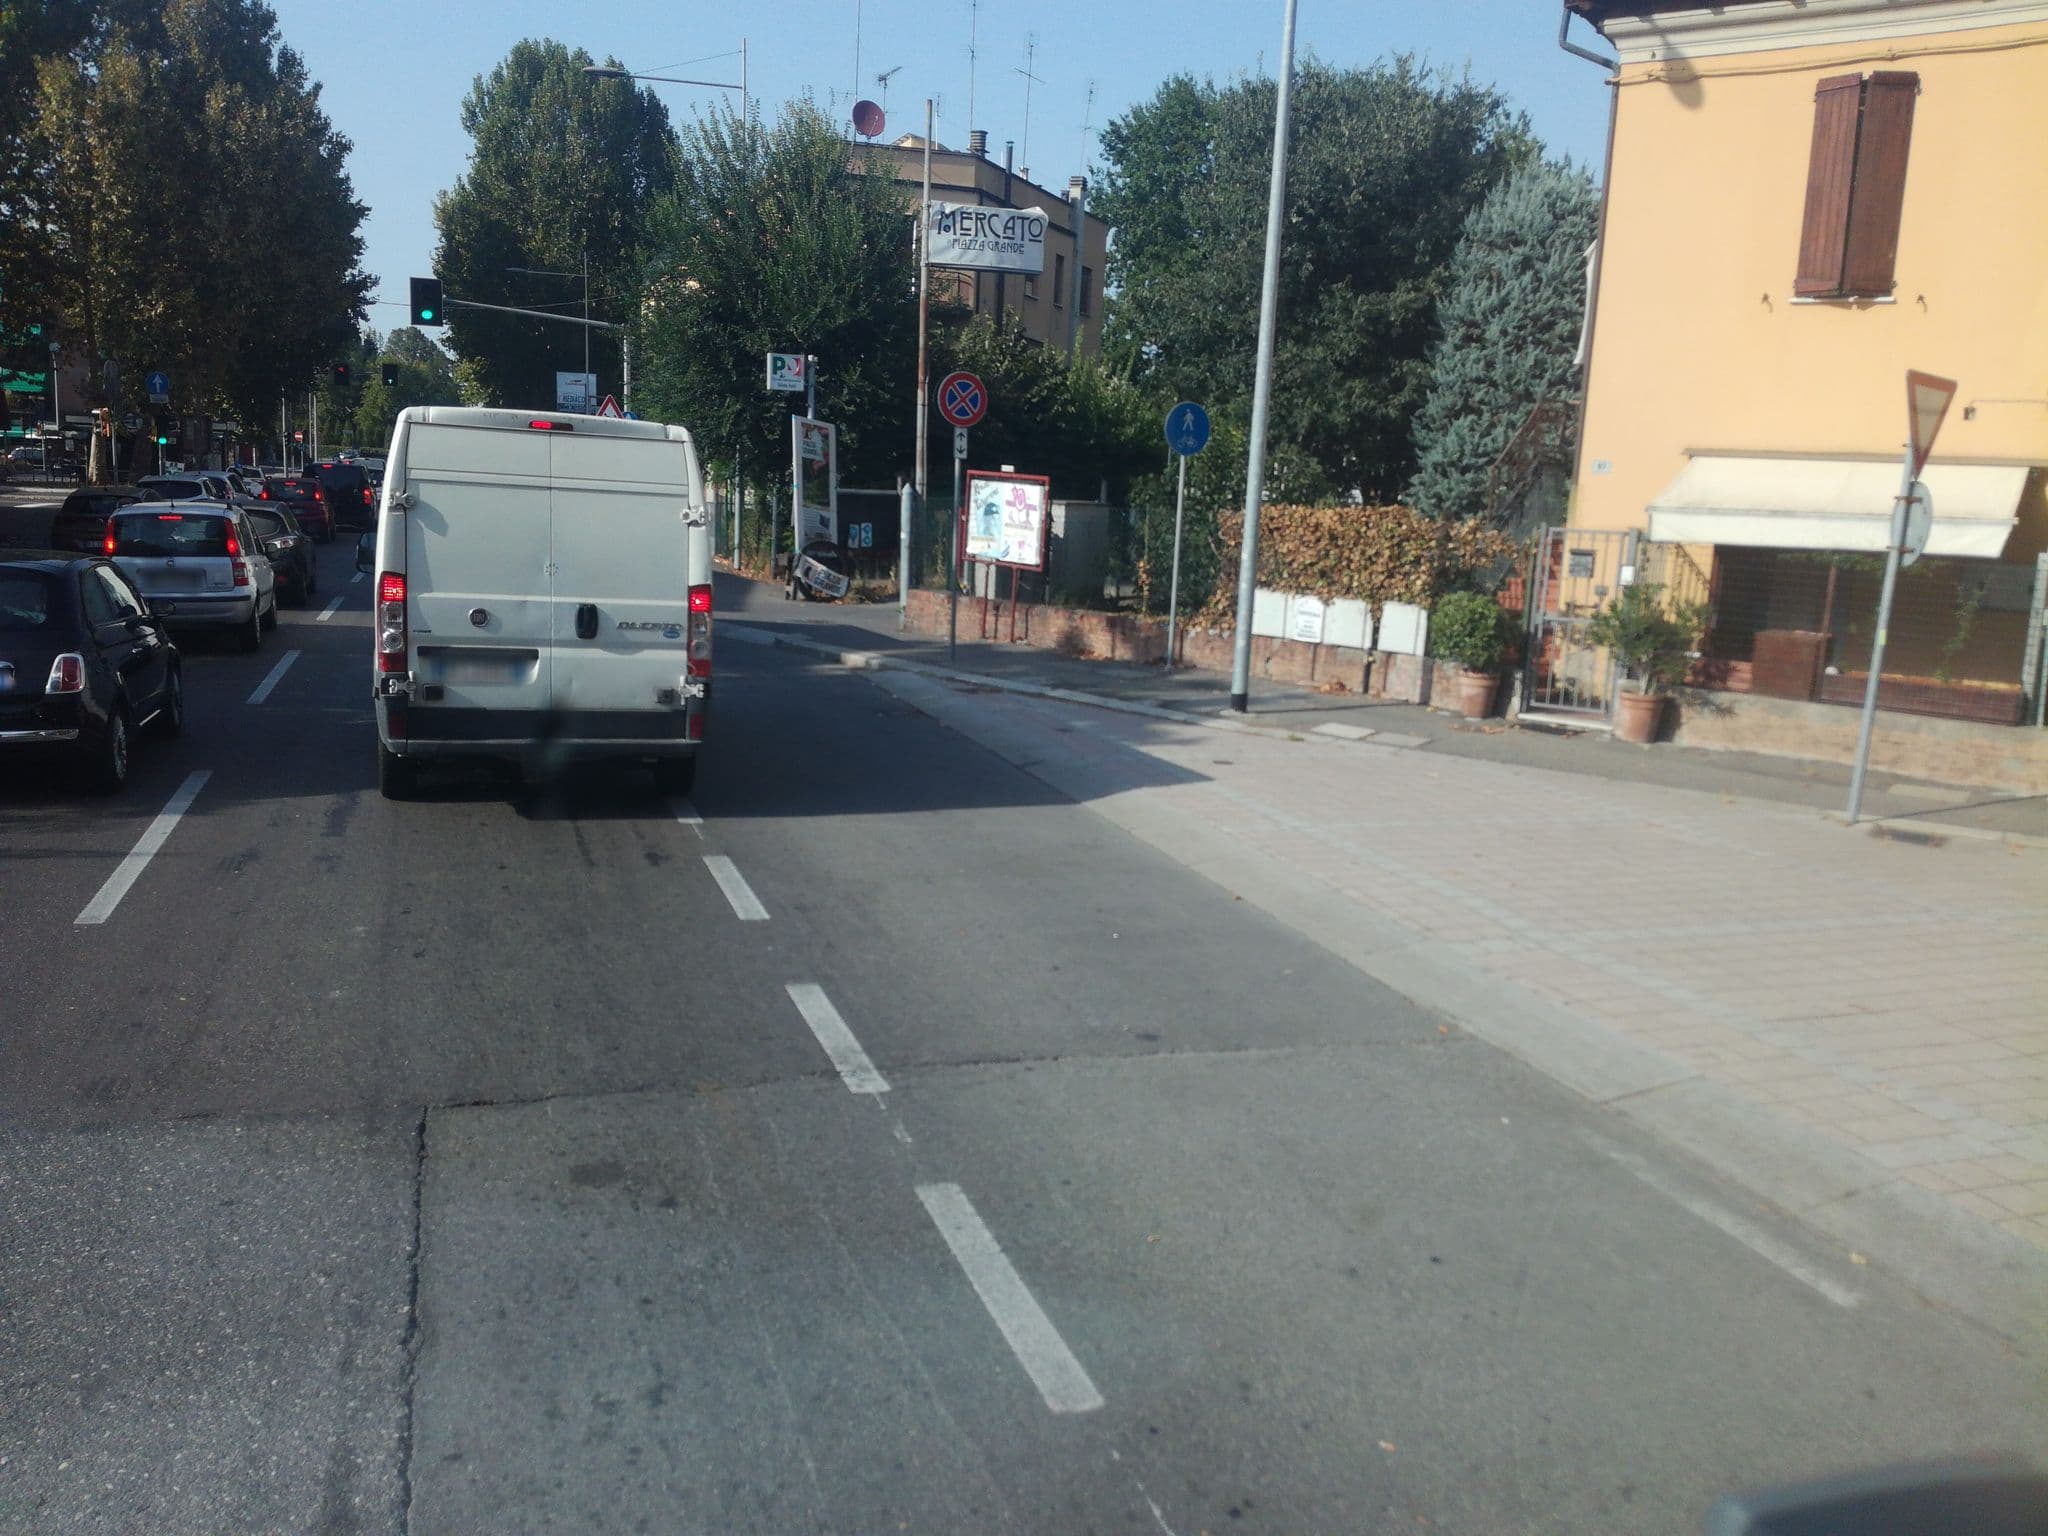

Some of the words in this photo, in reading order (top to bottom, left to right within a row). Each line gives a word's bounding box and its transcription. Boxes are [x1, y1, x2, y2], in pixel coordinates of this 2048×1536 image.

[937, 210, 1043, 243] MERCATO
[952, 239, 985, 252] PIAZZA
[987, 241, 1025, 255] GRANDE
